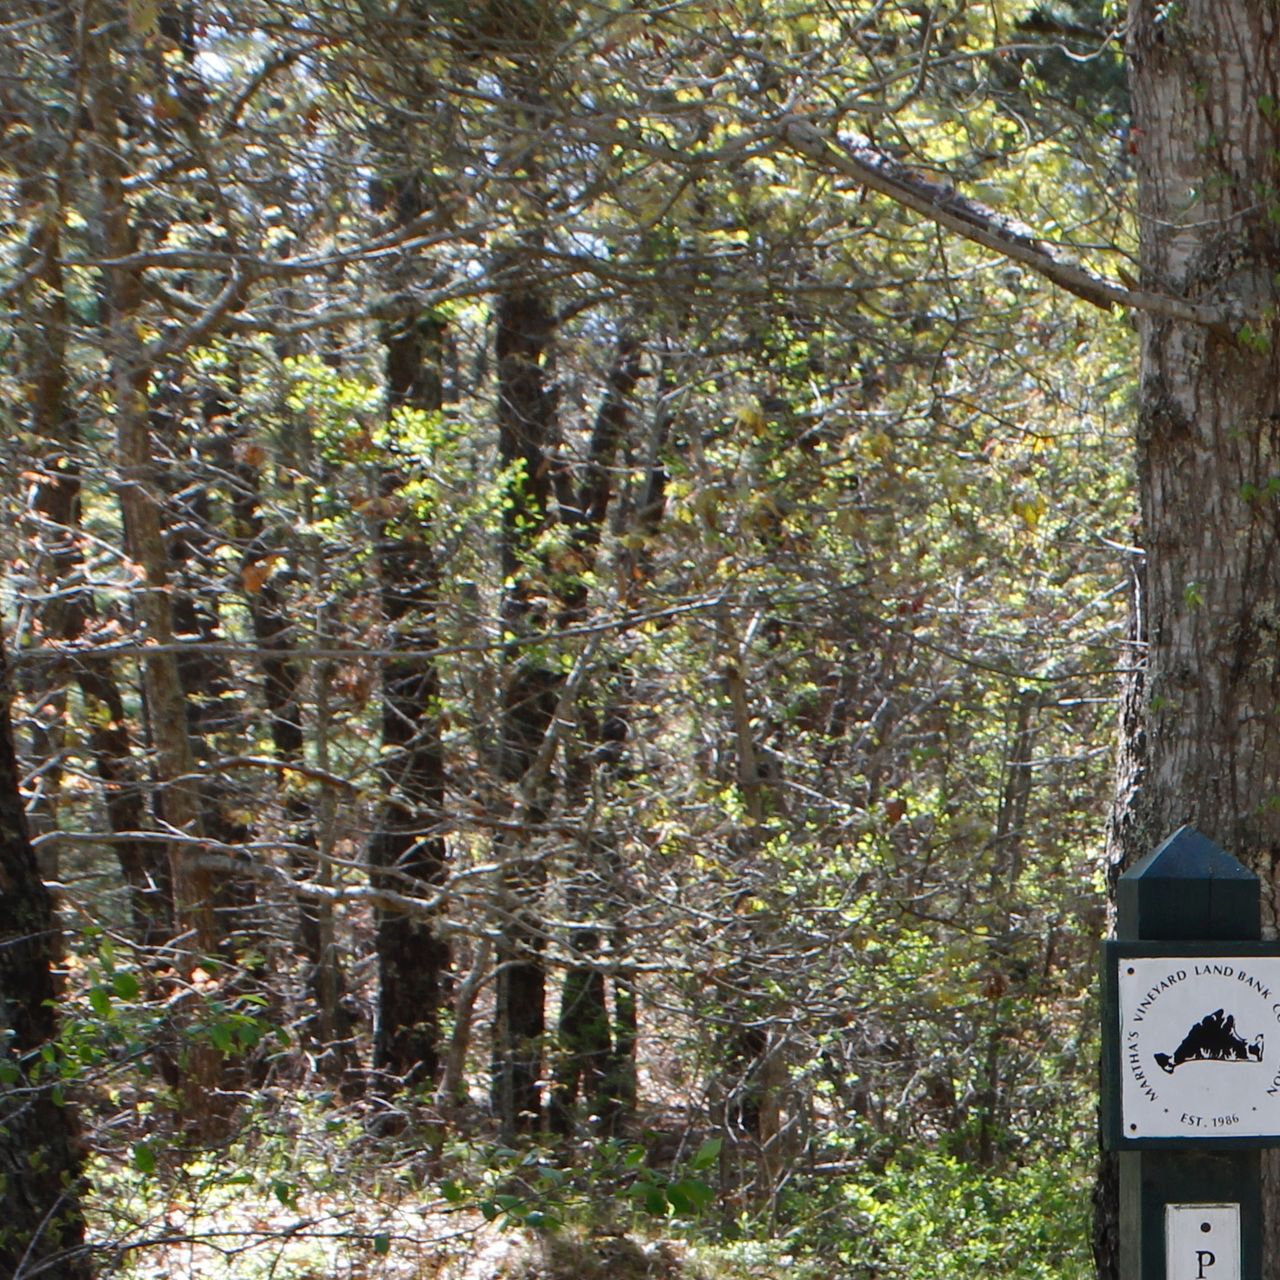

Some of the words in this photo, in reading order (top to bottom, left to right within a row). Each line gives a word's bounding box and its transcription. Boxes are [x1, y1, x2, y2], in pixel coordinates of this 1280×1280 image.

[1194, 965, 1234, 977] LAND
[1238, 971, 1272, 1000] BANK
[1133, 970, 1187, 1023] VINEYARD
[1127, 1031, 1159, 1102] MARTHA'S
[1180, 1113, 1207, 1128] EST.
[1212, 1114, 1239, 1128] 1986
